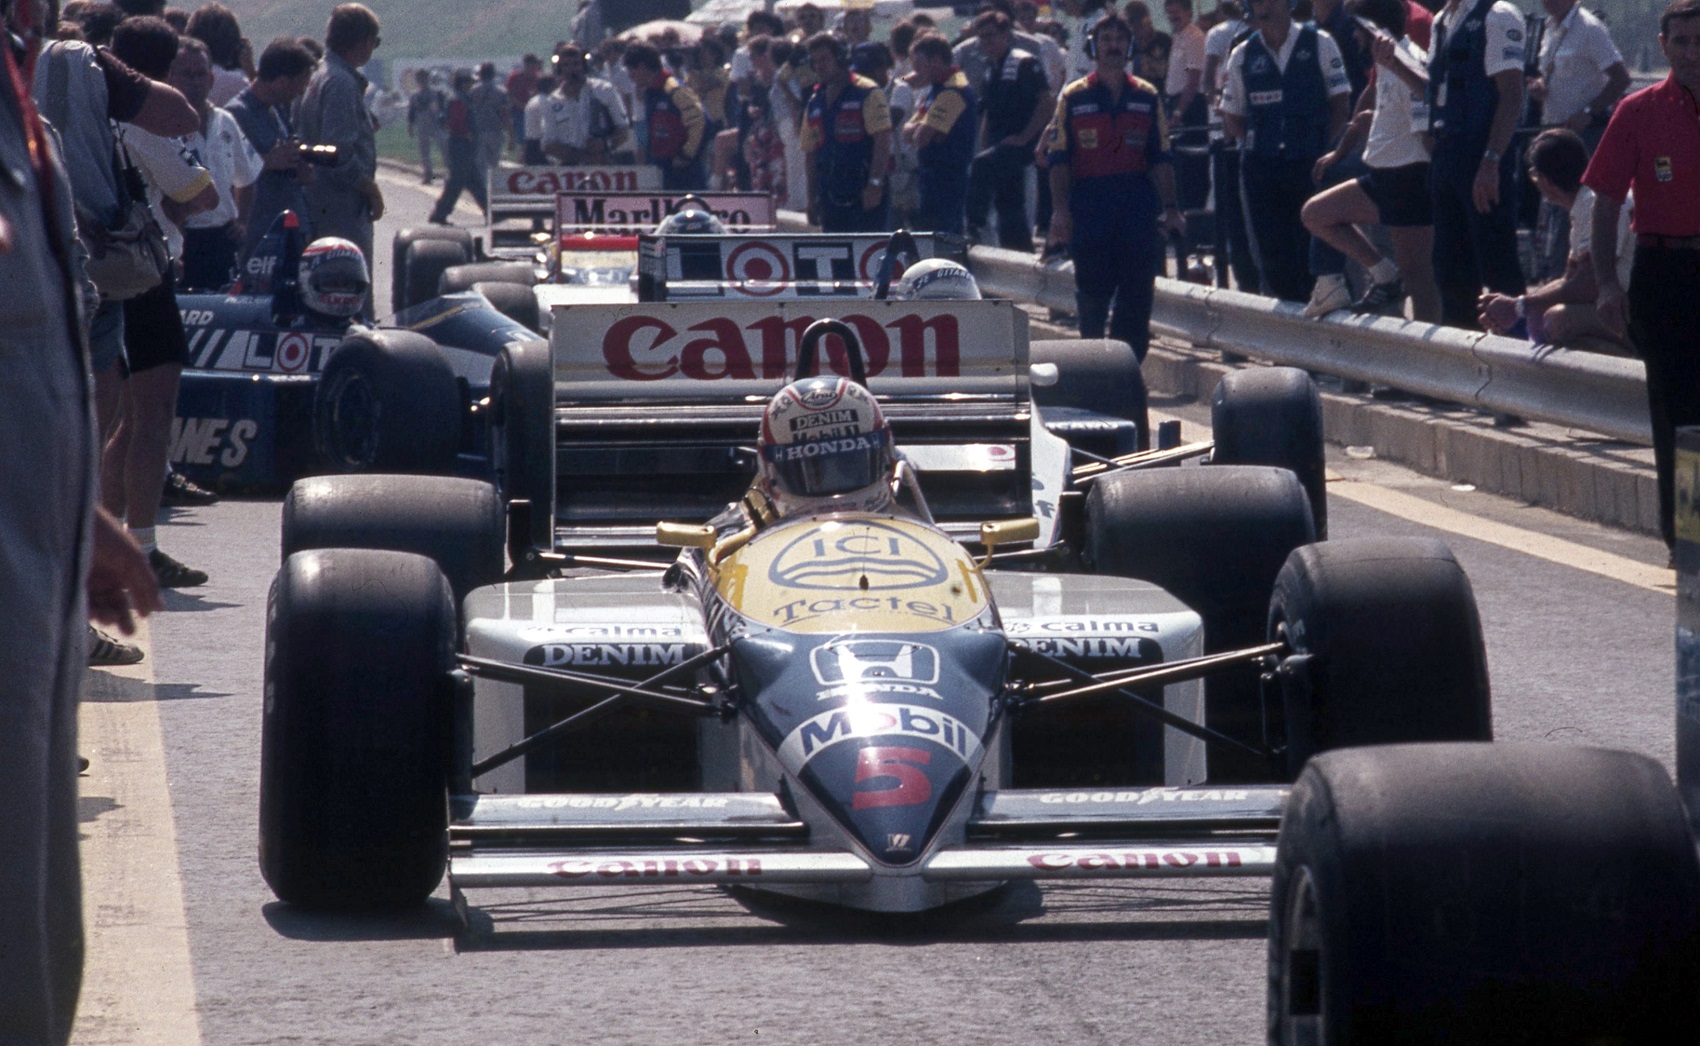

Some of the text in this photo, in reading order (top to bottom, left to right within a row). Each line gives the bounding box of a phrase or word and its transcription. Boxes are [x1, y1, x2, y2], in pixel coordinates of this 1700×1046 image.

[246, 254, 278, 275] elf
[795, 410, 852, 430] DENIM
[786, 436, 872, 461] HONDA
[812, 535, 901, 558] ICI
[773, 596, 955, 623] Tactel
[1041, 620, 1159, 633] calma
[541, 643, 687, 667] DENIM
[852, 746, 932, 811] 5
[547, 859, 762, 879] Canon
[1026, 852, 1242, 871] Canon
